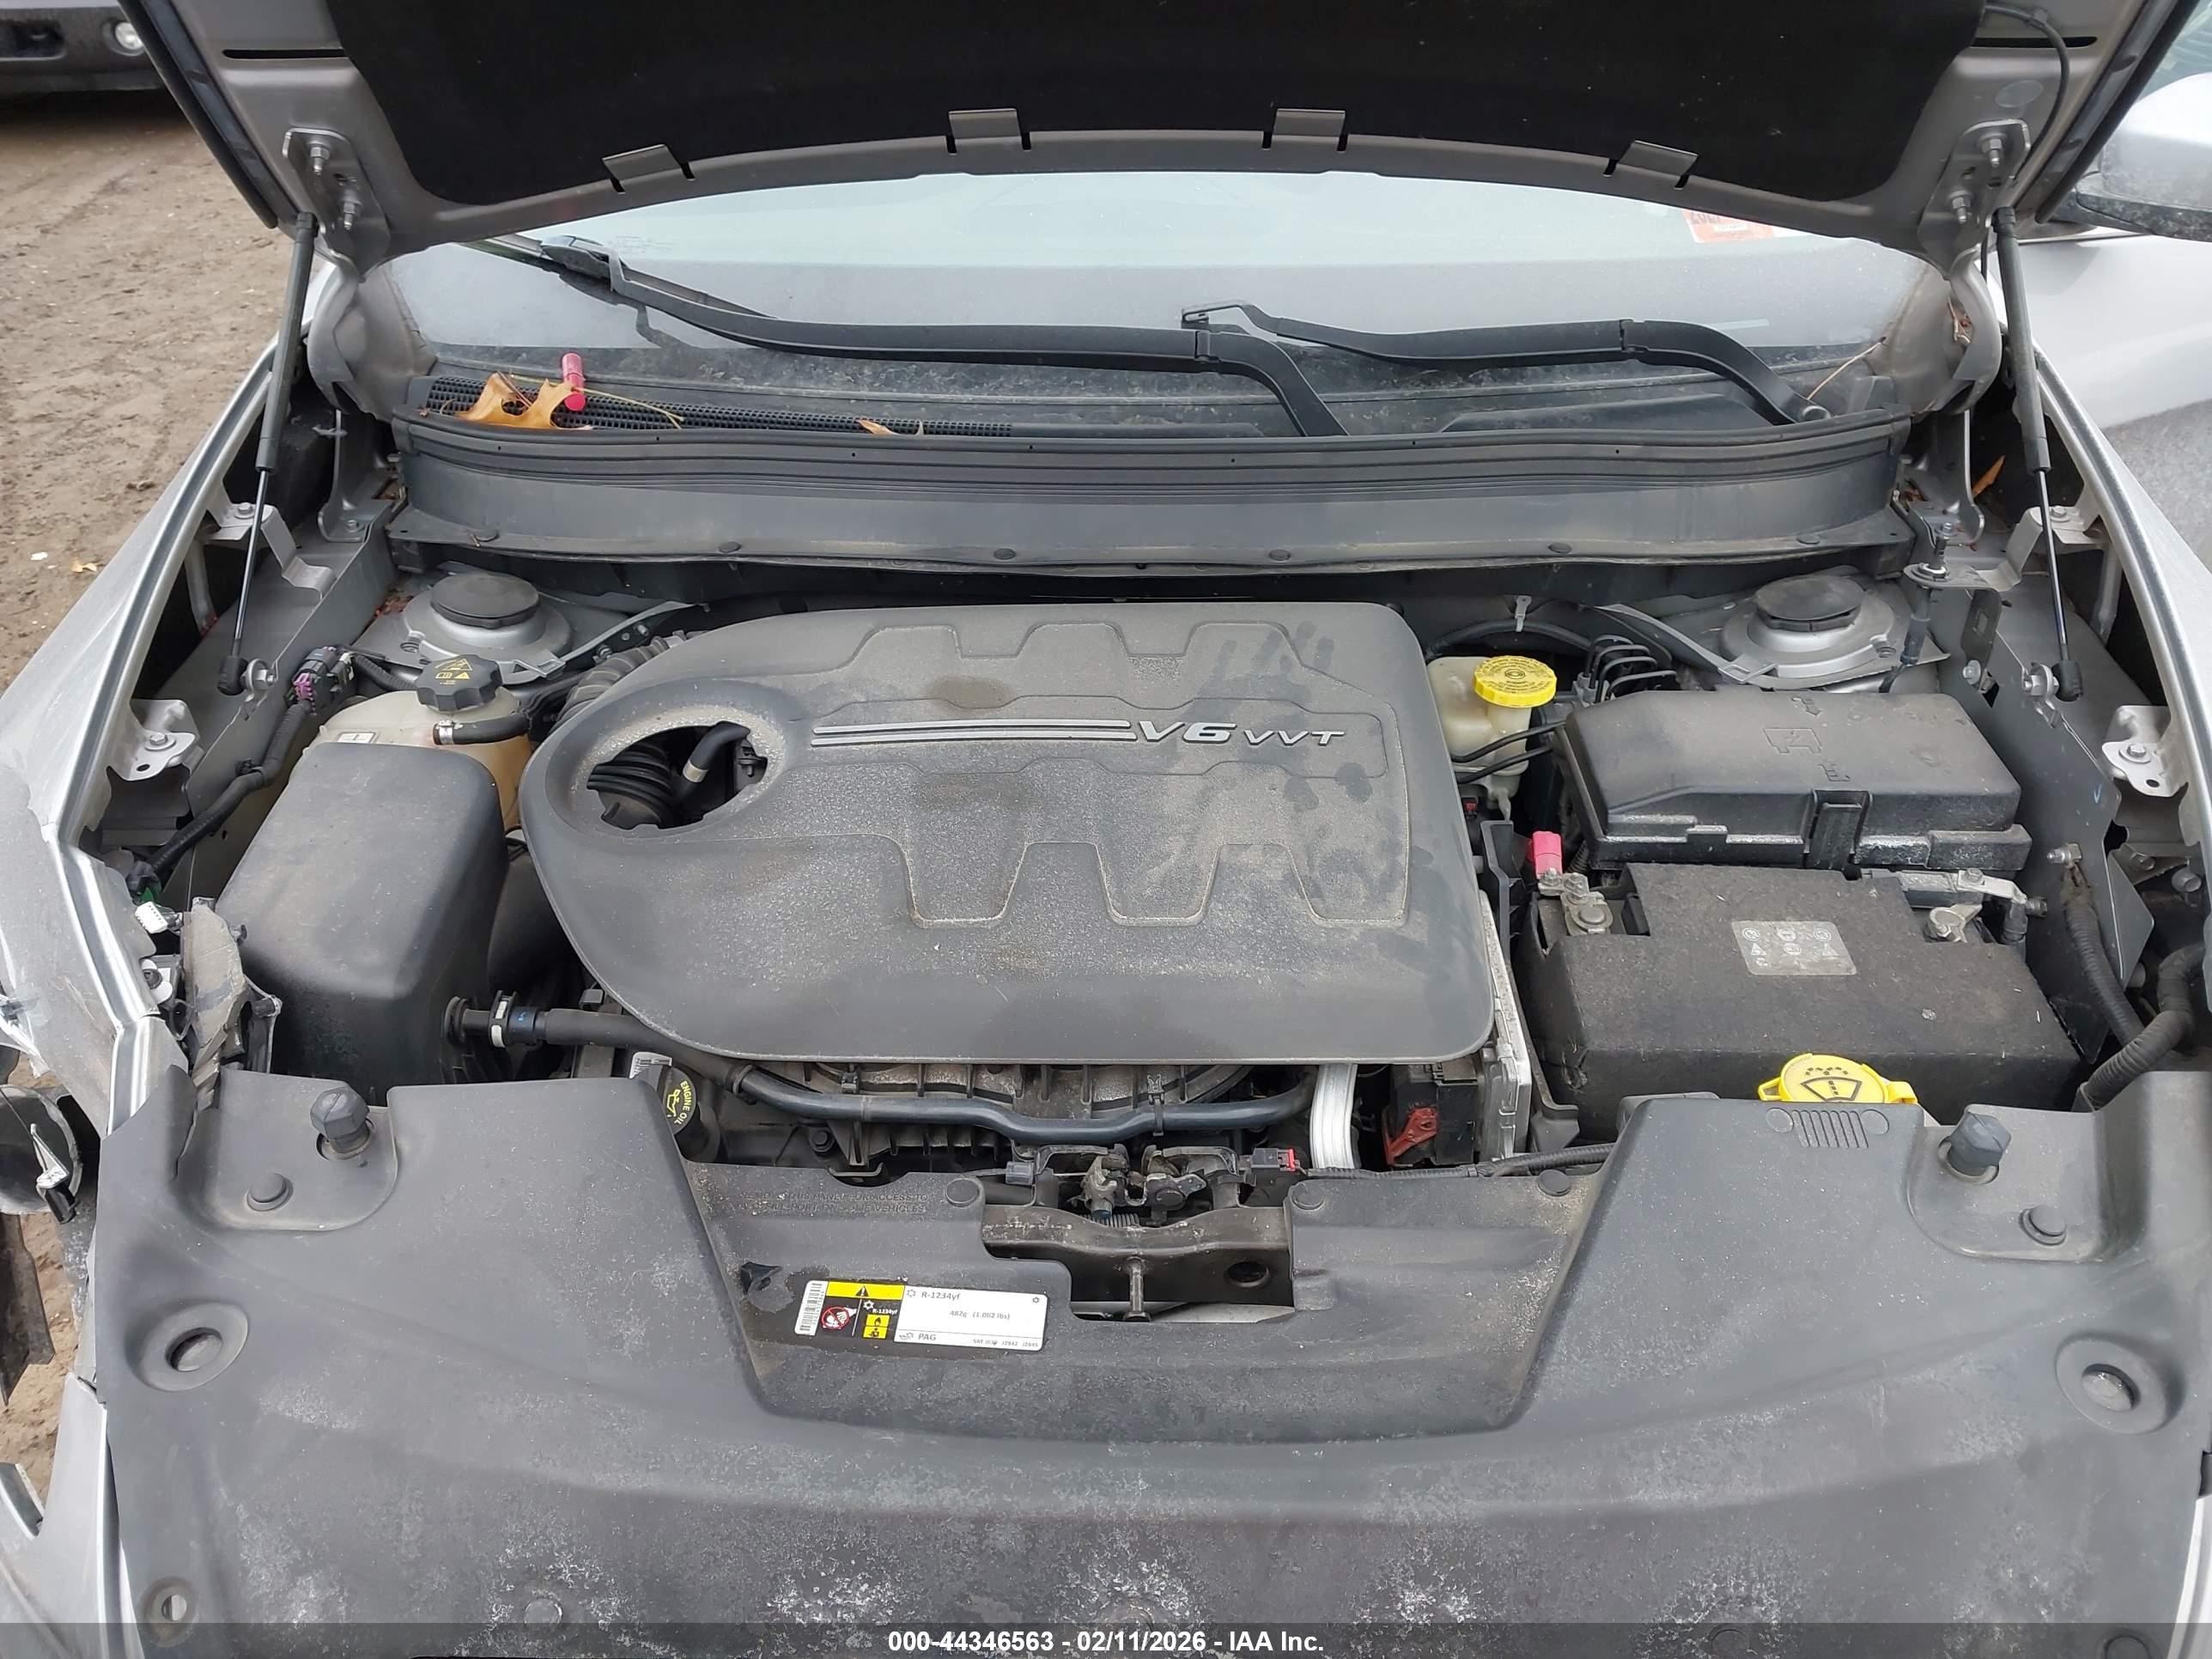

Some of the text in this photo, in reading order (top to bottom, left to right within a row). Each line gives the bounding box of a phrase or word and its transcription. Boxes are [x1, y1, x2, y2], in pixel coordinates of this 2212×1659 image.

[1138, 720, 1346, 746] V6 VVT
[673, 1080, 692, 1125] ENGINE OIL
[921, 1291, 961, 1301] R-1234yf
[918, 1333, 937, 1341] PAG
